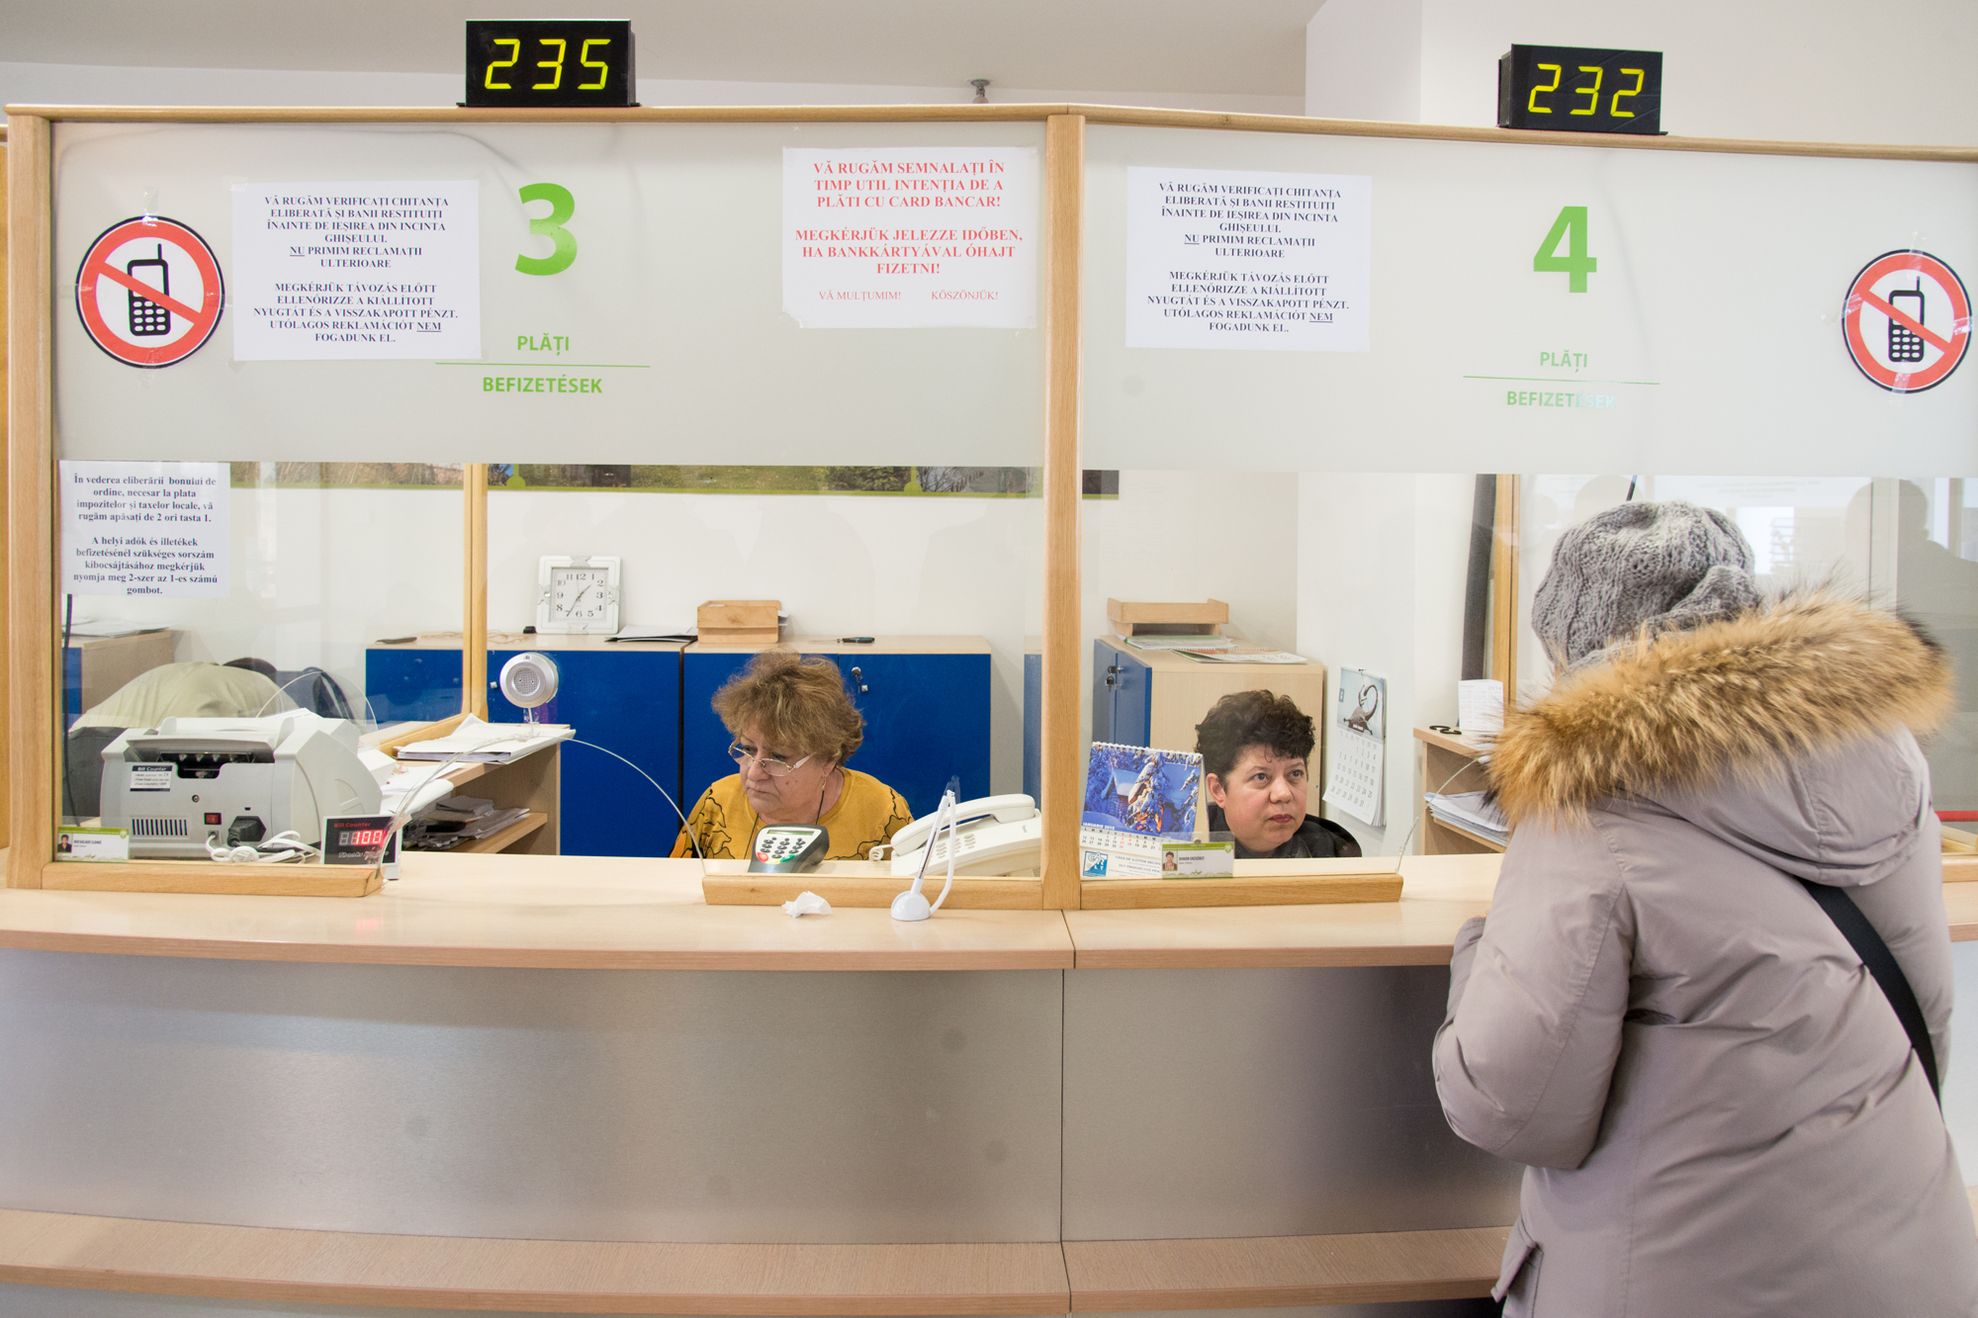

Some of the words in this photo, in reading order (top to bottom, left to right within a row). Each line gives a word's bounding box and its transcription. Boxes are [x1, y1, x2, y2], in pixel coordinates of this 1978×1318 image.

[485, 39, 611, 89] 235
[1528, 63, 1644, 117] 232
[815, 180, 851, 190] TIMP
[856, 180, 890, 190] UTIL
[970, 179, 988, 190] DE
[994, 180, 1003, 190] A
[865, 196, 884, 207] CU
[889, 197, 930, 207] CARD
[935, 196, 1000, 207] BANCAR!
[1243, 199, 1272, 207] BANII
[348, 210, 377, 218] BANII
[1210, 210, 1223, 218] DE
[1273, 212, 1290, 220] DIN
[1294, 213, 1337, 222] INCINTA
[315, 222, 328, 230] DE
[379, 222, 396, 230] DIN
[401, 222, 445, 231] INCINTA
[515, 183, 577, 276] 3
[893, 230, 957, 240] JELEZZE
[1184, 234, 1200, 245] NU
[1203, 235, 1243, 244] PRIMIM
[290, 247, 305, 257] NU
[308, 247, 349, 255] PRIMIM
[803, 247, 822, 257] HA
[1216, 248, 1284, 258] ULTERIOARE
[1533, 206, 1597, 293] 4
[321, 259, 391, 268] ULTERIOARE
[877, 263, 939, 274] FIZETNI!
[1229, 298, 1308, 308] VISSZAKAPOTT
[335, 309, 417, 317] VISSZAKAPOTT
[1309, 313, 1333, 323] NEM
[417, 322, 441, 332] NEM
[1210, 322, 1269, 332] FOGADUNK
[1273, 324, 1288, 332] EL.
[316, 333, 376, 342] FOGADUNK
[380, 334, 395, 342] EL.
[517, 333, 569, 356] PLĂȚI
[1540, 350, 1587, 372] PLĂȚI
[483, 374, 602, 393] BEFIZETÉSEK
[86, 476, 120, 484] vederea
[93, 488, 124, 496] ordine,
[163, 489, 171, 497] la
[174, 489, 196, 499] plata
[139, 501, 170, 509] taxelor
[173, 501, 200, 510] locale,
[144, 513, 154, 521] de
[157, 513, 162, 521] 2
[205, 514, 211, 522] 1.
[102, 537, 123, 546] helyi
[74, 573, 105, 582] nyomja
[108, 575, 126, 583] meg
[129, 573, 155, 582] 2-szer
[127, 586, 162, 595] gombot.
